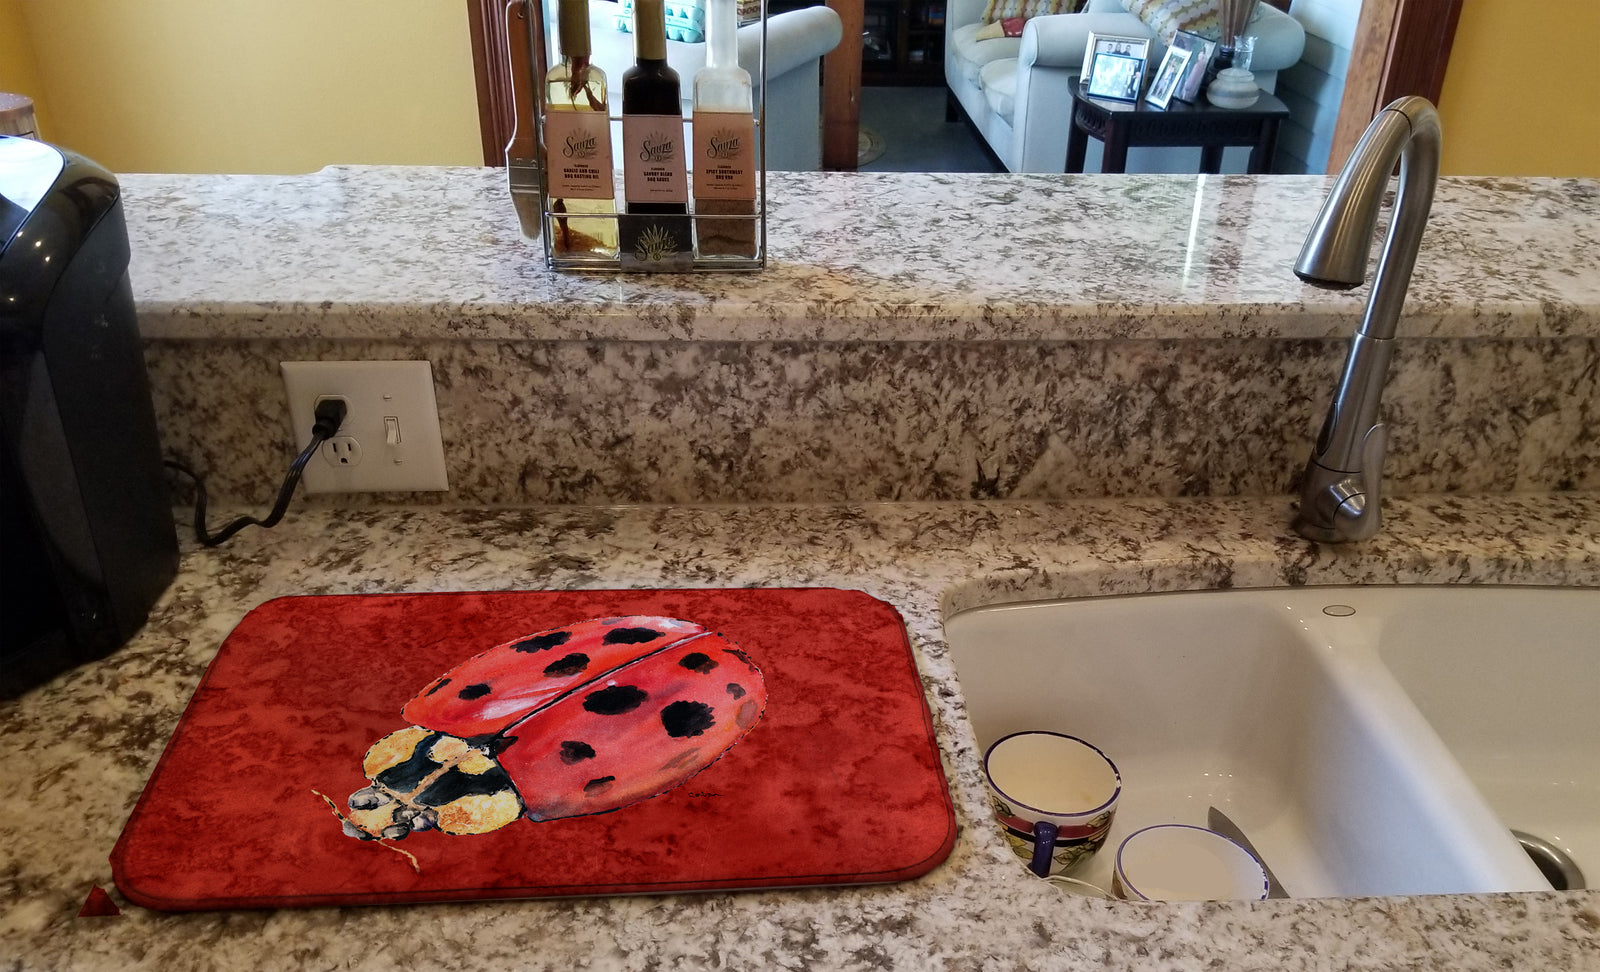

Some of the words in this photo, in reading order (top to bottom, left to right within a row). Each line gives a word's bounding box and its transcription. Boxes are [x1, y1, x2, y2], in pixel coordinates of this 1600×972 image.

[563, 136, 598, 158] Sauza
[640, 140, 675, 161] Sauza
[707, 136, 742, 159] Sauza
